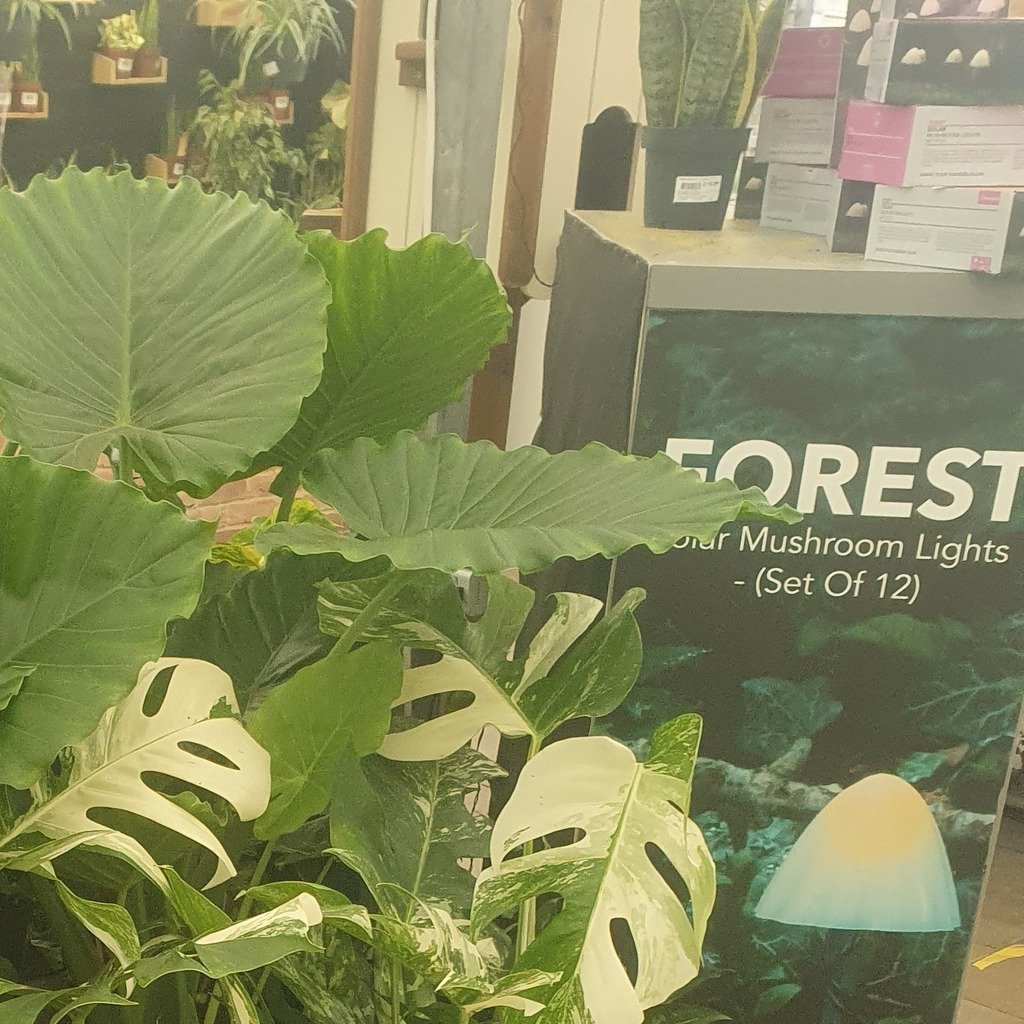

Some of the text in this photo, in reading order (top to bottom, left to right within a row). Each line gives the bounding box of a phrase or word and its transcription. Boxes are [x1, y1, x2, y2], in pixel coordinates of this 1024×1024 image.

[739, 526, 902, 559] Mushroom
[915, 533, 1010, 569] Lights
[755, 567, 814, 597] (Set
[824, 570, 865, 597] Of
[876, 573, 921, 605] 12)
